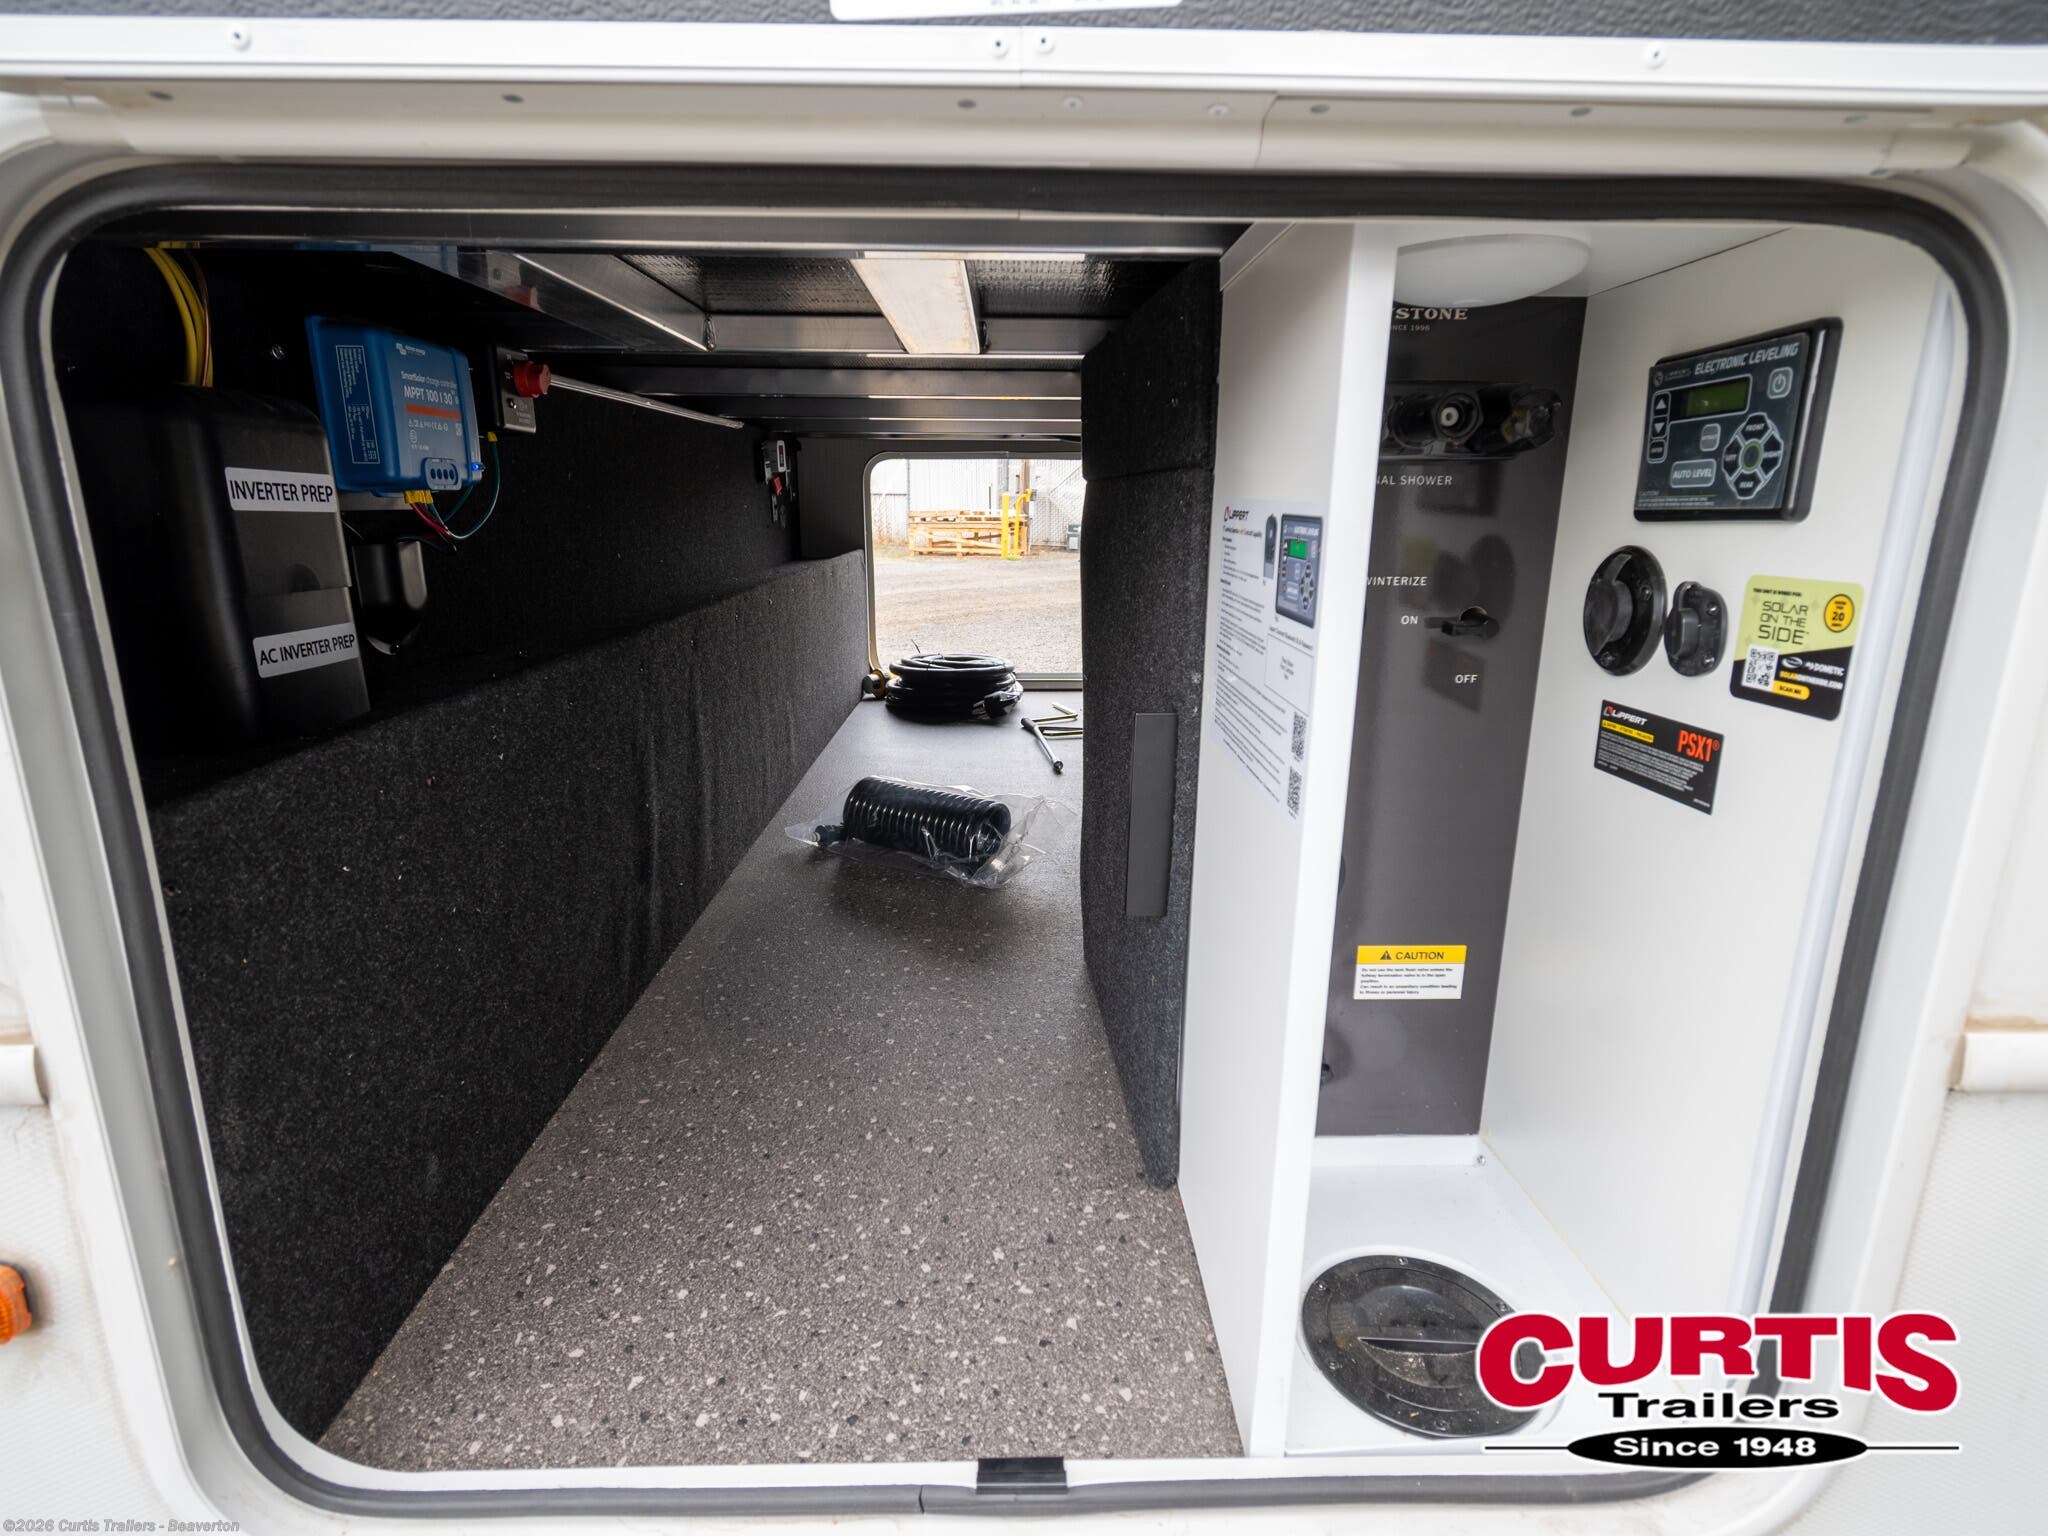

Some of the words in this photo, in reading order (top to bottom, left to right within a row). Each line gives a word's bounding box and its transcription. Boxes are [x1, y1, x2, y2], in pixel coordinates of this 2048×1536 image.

[1392, 307, 1469, 320] STONE
[1694, 354, 1748, 375] ELECTRONIC
[1749, 343, 1799, 364] LEVELING
[404, 385, 424, 401] MPPT
[425, 388, 438, 403] 100
[443, 392, 452, 405] 30
[1400, 475, 1453, 486] SHOWER
[1672, 470, 1691, 479] AUTO
[1692, 468, 1712, 478] LEVEL
[230, 480, 299, 501] INVERTER
[301, 484, 333, 503] PREP
[1762, 600, 1809, 616] SOLAR
[1400, 615, 1418, 625] ON
[1760, 612, 1779, 623] ON
[1783, 615, 1808, 628] THE
[1831, 611, 1845, 622] 20
[260, 648, 278, 666] AC
[280, 638, 331, 662] INVERTER
[332, 634, 355, 649] PREP
[1455, 674, 1478, 684] OFF
[1612, 709, 1648, 726] LIPPERT
[1395, 951, 1445, 960] CAUTION
